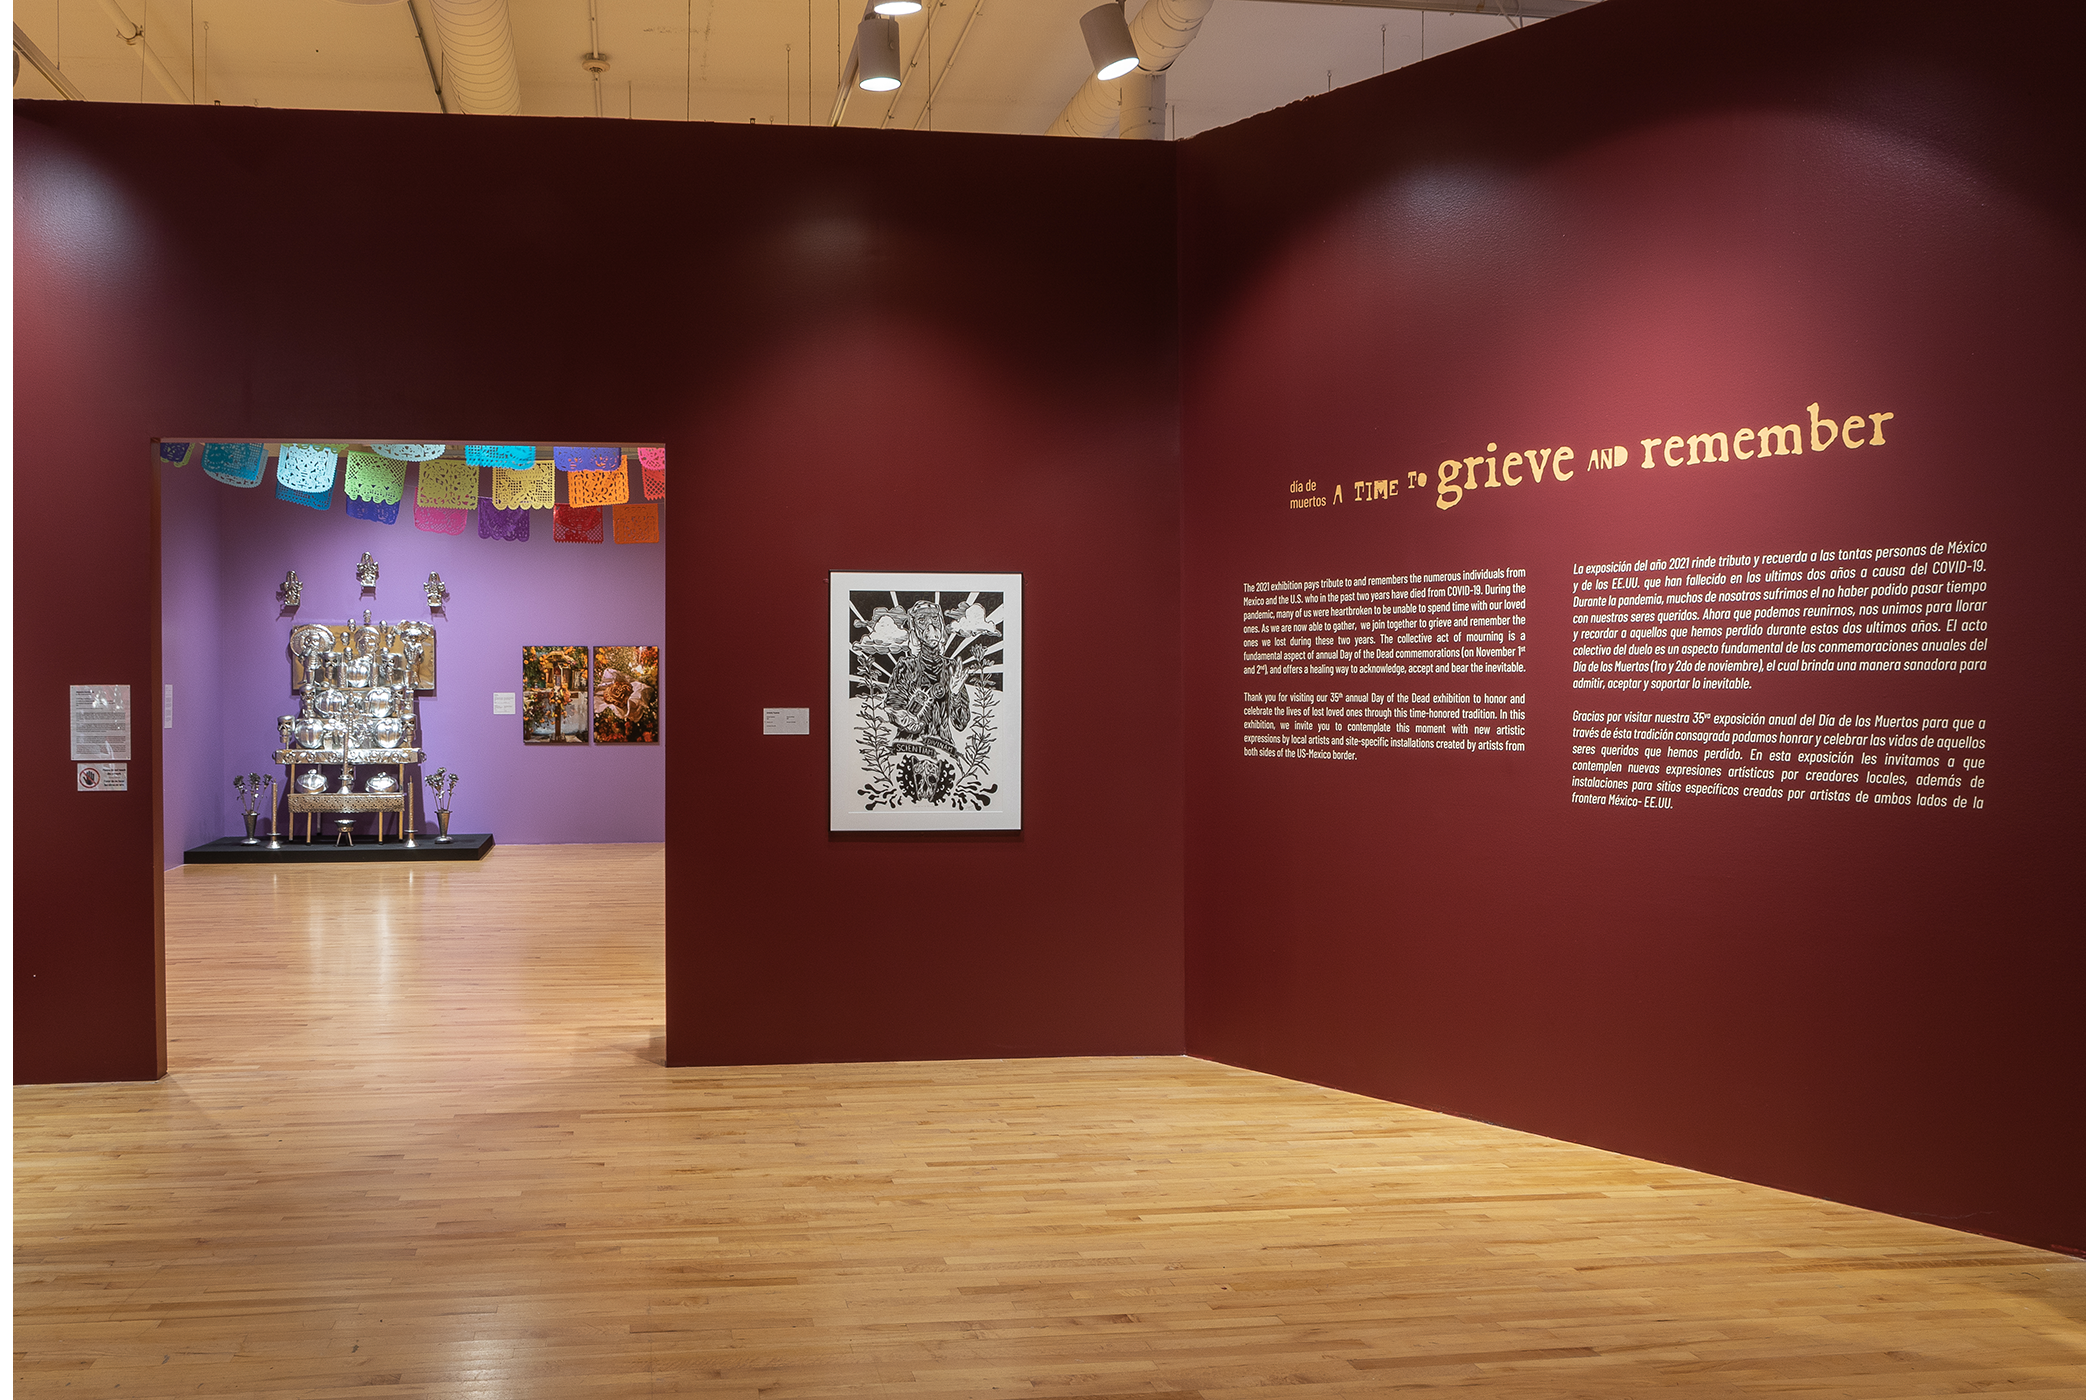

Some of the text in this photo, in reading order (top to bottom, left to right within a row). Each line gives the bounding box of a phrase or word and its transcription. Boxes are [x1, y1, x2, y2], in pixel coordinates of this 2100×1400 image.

[1332, 402, 1895, 511] A TIME TO grieve AND remember
[1290, 479, 1317, 494] día de
[1290, 496, 1327, 509] muertos
[1243, 567, 1526, 592] The 2021 exhibition pays tribute to and remembers the numerous individuals from
[1572, 559, 1986, 594] y de los EE.UU. que han fallecido en los ultimos dos años a causa del COVID-19.
[1243, 598, 1526, 622] pandemic, many of us were heartbroken to be unable to spend time with our loved
[1572, 599, 1987, 624] con nuestros seres queridos. Ahora que podemos reunirnos, nos unimos para llorar
[1243, 630, 1526, 648] ones we lost during these two years. The collective act of mourning is a
[1572, 618, 1988, 642] y recordar a aquellos que hemos perdido durante estos dos ultimos años. El acto
[1243, 706, 1526, 720] celebrate the lives of lost loved ones through this time-honored tradition. In this
[1572, 709, 1986, 732] Gracias por visitar nuestra 35va exposición anual del Día de los Muertos para que a
[1243, 733, 1525, 752] expressions by local artists and site-specific installations created by artists from
[1571, 775, 1984, 809] instalaciones para sitios específicos creadas por artistas de ambos lados de la
[1571, 791, 1673, 809] frontera México- EE.UU.
